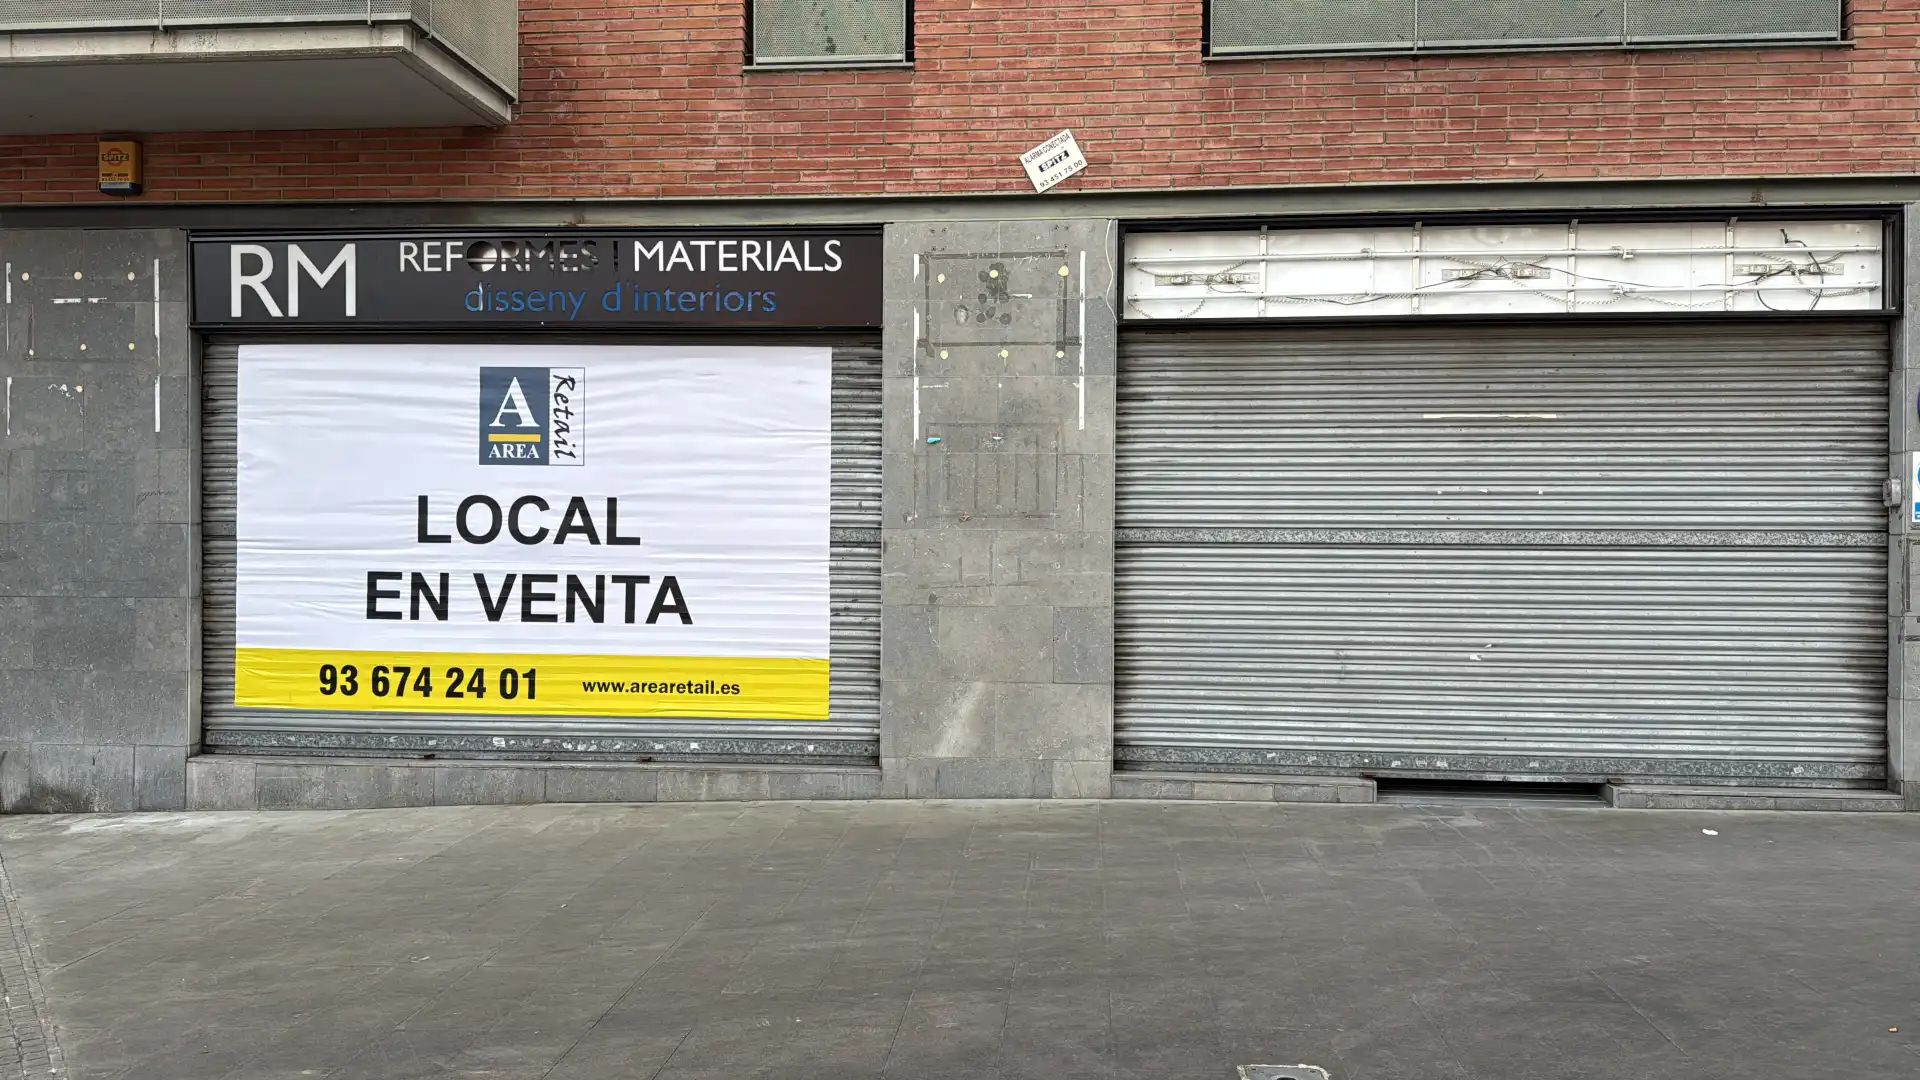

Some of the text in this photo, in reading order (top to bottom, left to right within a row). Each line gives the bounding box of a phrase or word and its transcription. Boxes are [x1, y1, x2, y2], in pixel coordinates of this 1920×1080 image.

[1024, 133, 1070, 164] ALARMA CONECTADA
[1041, 151, 1068, 171] SPITZ
[1040, 159, 1083, 188] 93 451 75 00
[399, 241, 599, 272] REFORMES
[633, 240, 843, 272] MATERIALS
[230, 243, 356, 318] RM
[464, 281, 777, 321] disseny d'interiors
[488, 376, 541, 428] A
[553, 374, 577, 459] Retail
[488, 443, 540, 459] AREA
[417, 494, 641, 546] LOCAL
[366, 570, 694, 625] EN VENTA
[319, 664, 741, 700] 93 674 24 01 www.arearetail.es
